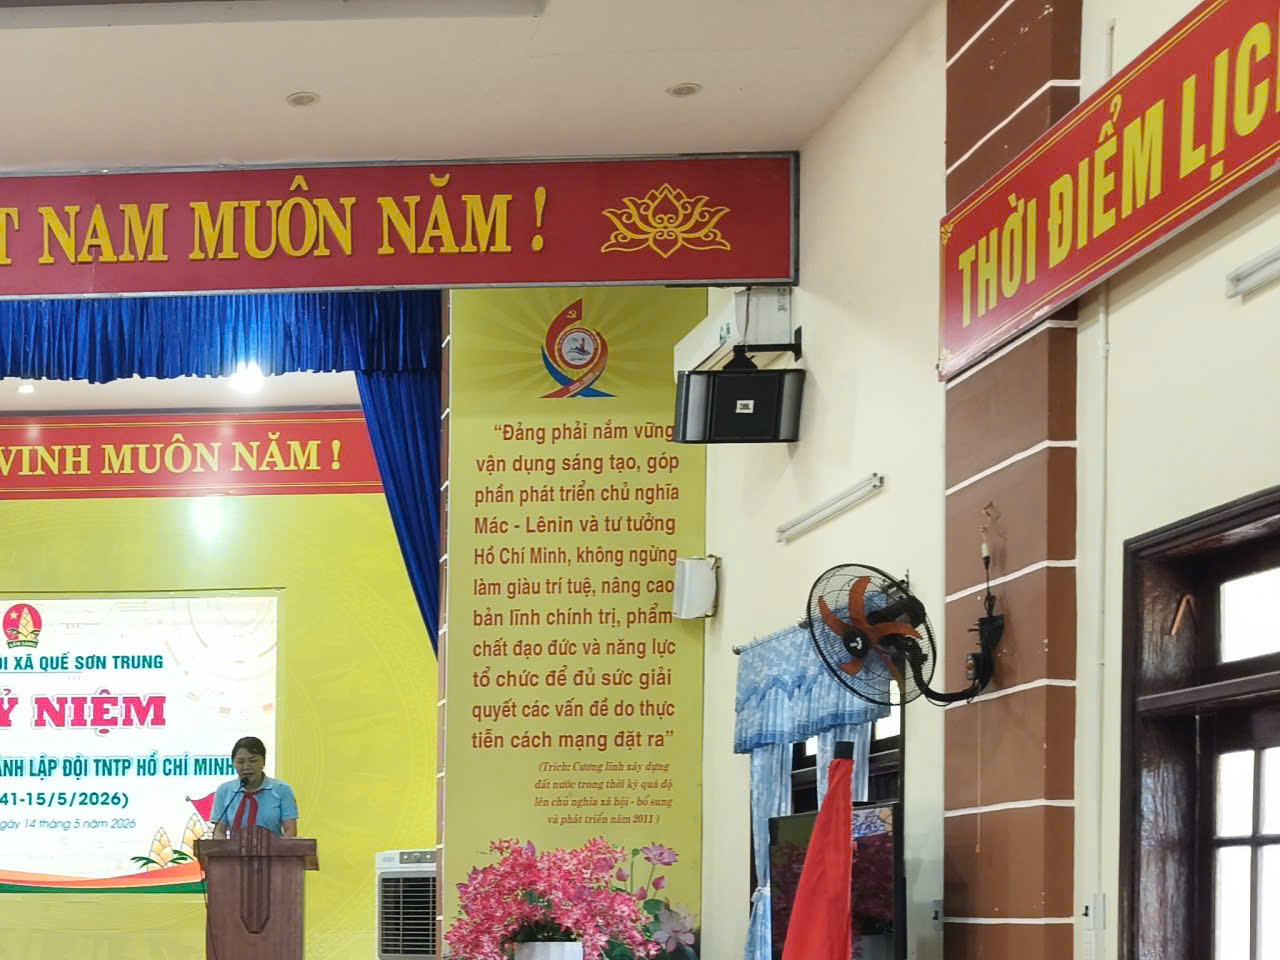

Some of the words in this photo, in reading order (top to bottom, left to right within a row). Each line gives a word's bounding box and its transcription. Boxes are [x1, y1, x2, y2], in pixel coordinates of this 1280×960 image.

[958, 192, 1037, 328] THỜI
[1048, 94, 1165, 269] ĐIỂM
[1179, 8, 1280, 182] LỊC
[38, 202, 169, 264] NAM
[189, 175, 357, 260] MUÔN
[376, 173, 512, 256] NĂM
[531, 186, 547, 252] !
[552, 420, 588, 445] phải
[593, 419, 628, 439] nắm
[634, 421, 673, 442] vững
[101, 433, 222, 475] MUÔN
[231, 431, 322, 473] NĂM
[331, 440, 341, 470] !
[476, 455, 506, 476] vận
[512, 455, 556, 475] dụng
[561, 453, 603, 475] sáng
[609, 454, 641, 473] tạo,
[647, 452, 679, 474] góp
[475, 483, 514, 508] phần
[520, 485, 555, 507] phát
[559, 480, 595, 502] triển
[600, 482, 630, 501] chủ
[635, 483, 679, 505] nghĩa
[474, 545, 495, 565] Hồ
[499, 547, 526, 564] Chí
[530, 547, 571, 566] Minh,
[576, 546, 624, 567] không
[629, 545, 677, 566] ngừng
[473, 607, 504, 627] bản
[510, 609, 540, 626] lĩnh
[546, 608, 592, 625] chính
[598, 608, 620, 628] trị,
[626, 602, 672, 628] phẩm
[14, 653, 33, 671] XÃ
[39, 651, 69, 671] QUẾ
[75, 654, 106, 670] SƠN
[112, 654, 164, 670] TRUNG
[473, 637, 508, 657] chất
[513, 640, 543, 660] đạo
[548, 638, 577, 656] đức
[582, 638, 600, 655] và
[606, 638, 648, 659] năng
[652, 638, 676, 658] lực
[34, 688, 167, 734] NIỆM
[472, 729, 504, 748] tiễn
[511, 731, 552, 748] cách
[559, 735, 608, 752] mạng
[614, 730, 642, 751] đặt
[29, 755, 57, 780] LẬP
[62, 755, 88, 780] ĐỘI
[94, 759, 131, 776] TNTP
[137, 751, 157, 776] HỒ
[163, 754, 188, 776] CHÍ
[194, 758, 235, 776] MINH
[25, 818, 36, 828] 14
[73, 818, 80, 829] 5
[111, 818, 137, 829] 2026
